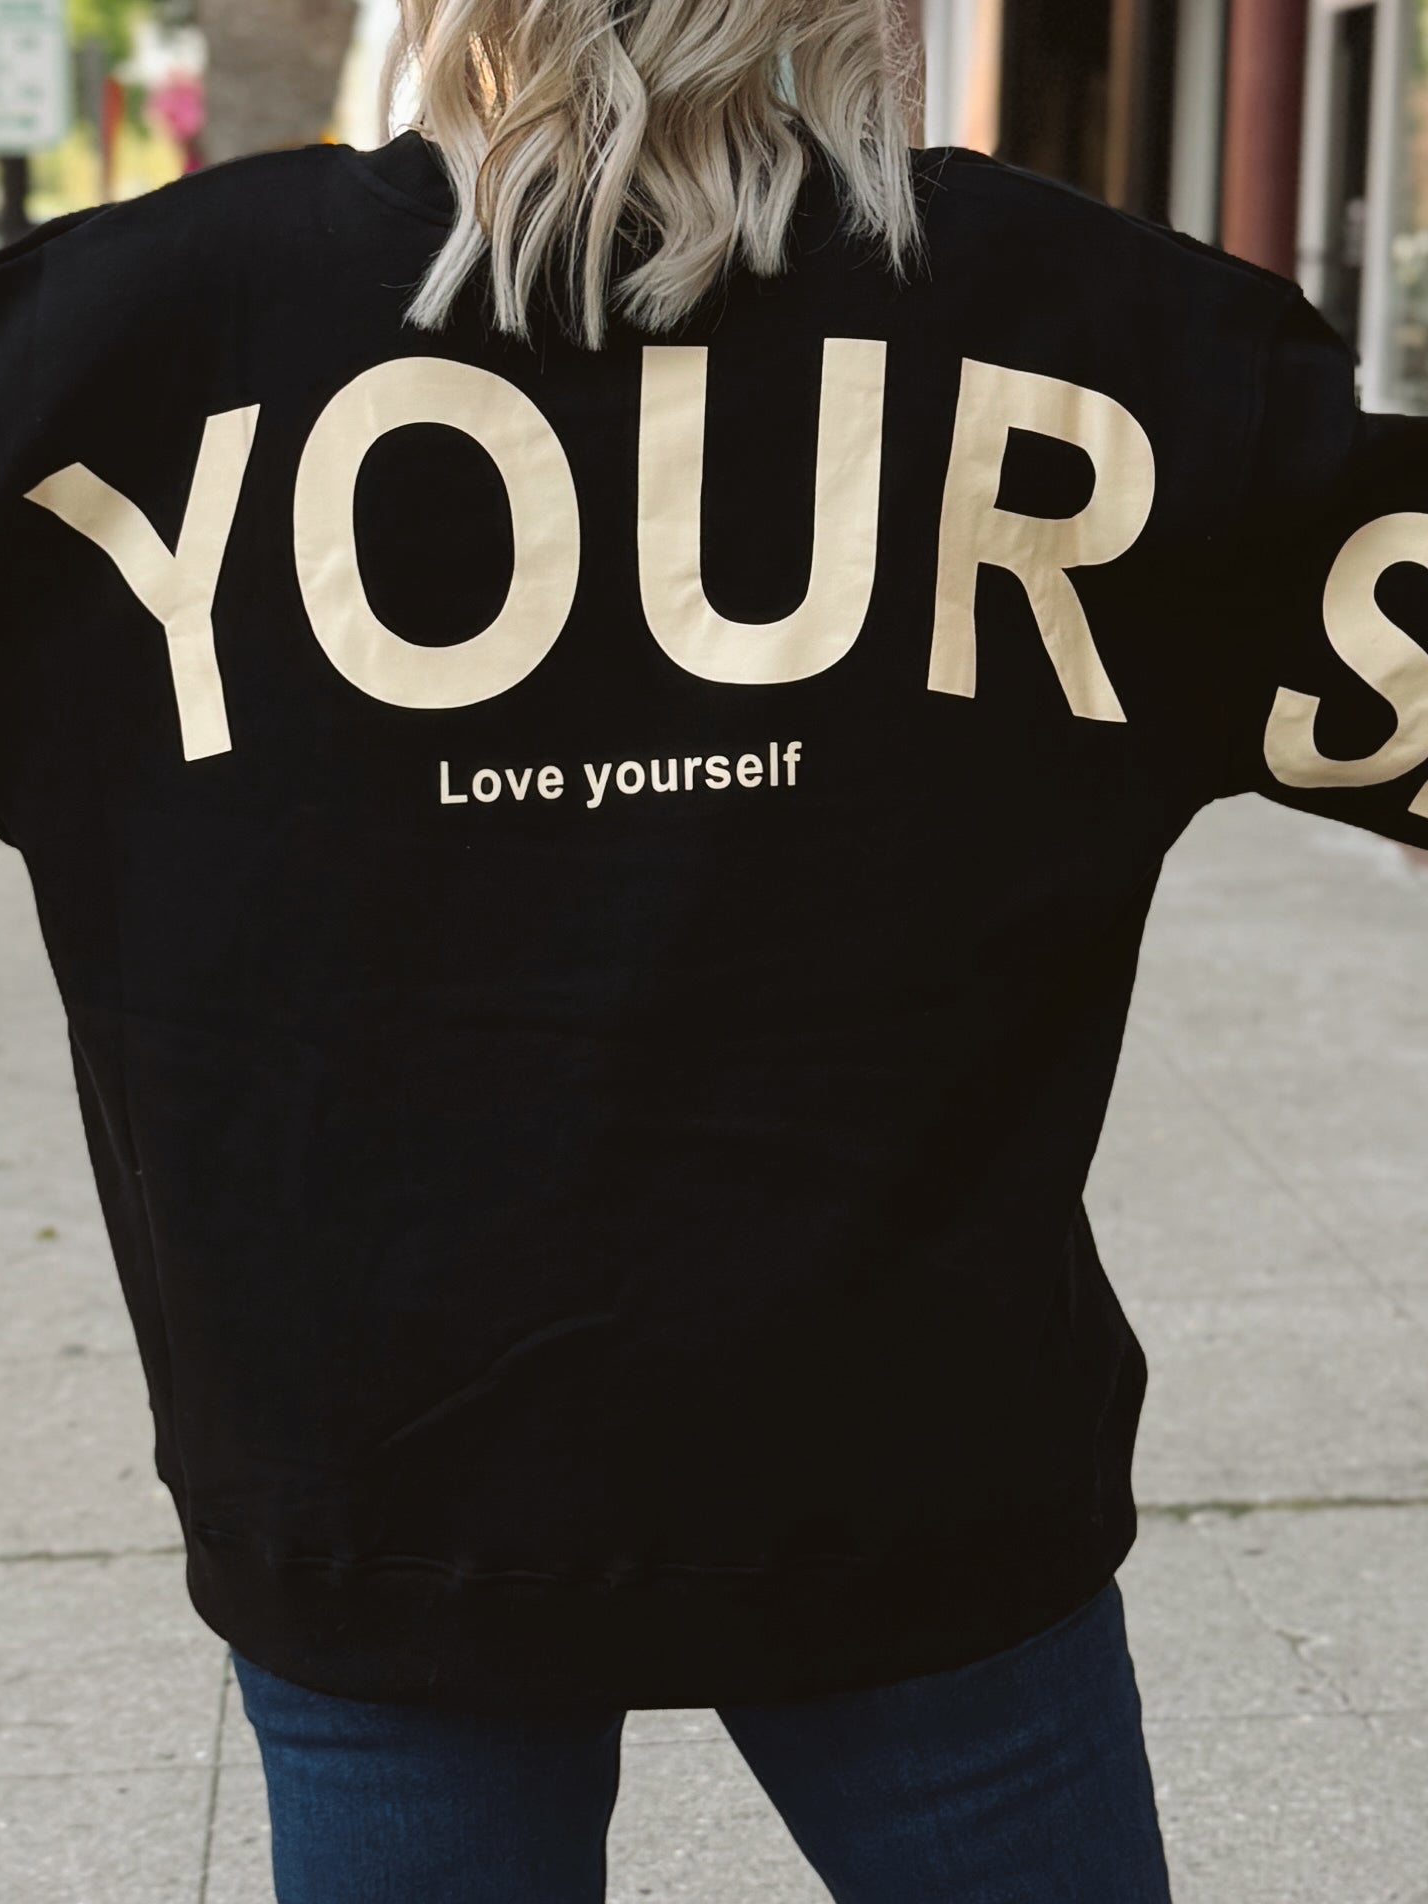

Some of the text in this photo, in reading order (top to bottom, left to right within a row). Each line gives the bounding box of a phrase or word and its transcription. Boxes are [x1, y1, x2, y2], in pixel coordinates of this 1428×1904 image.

[22, 337, 1156, 762] YOUR
[439, 740, 803, 809] Love yourself
